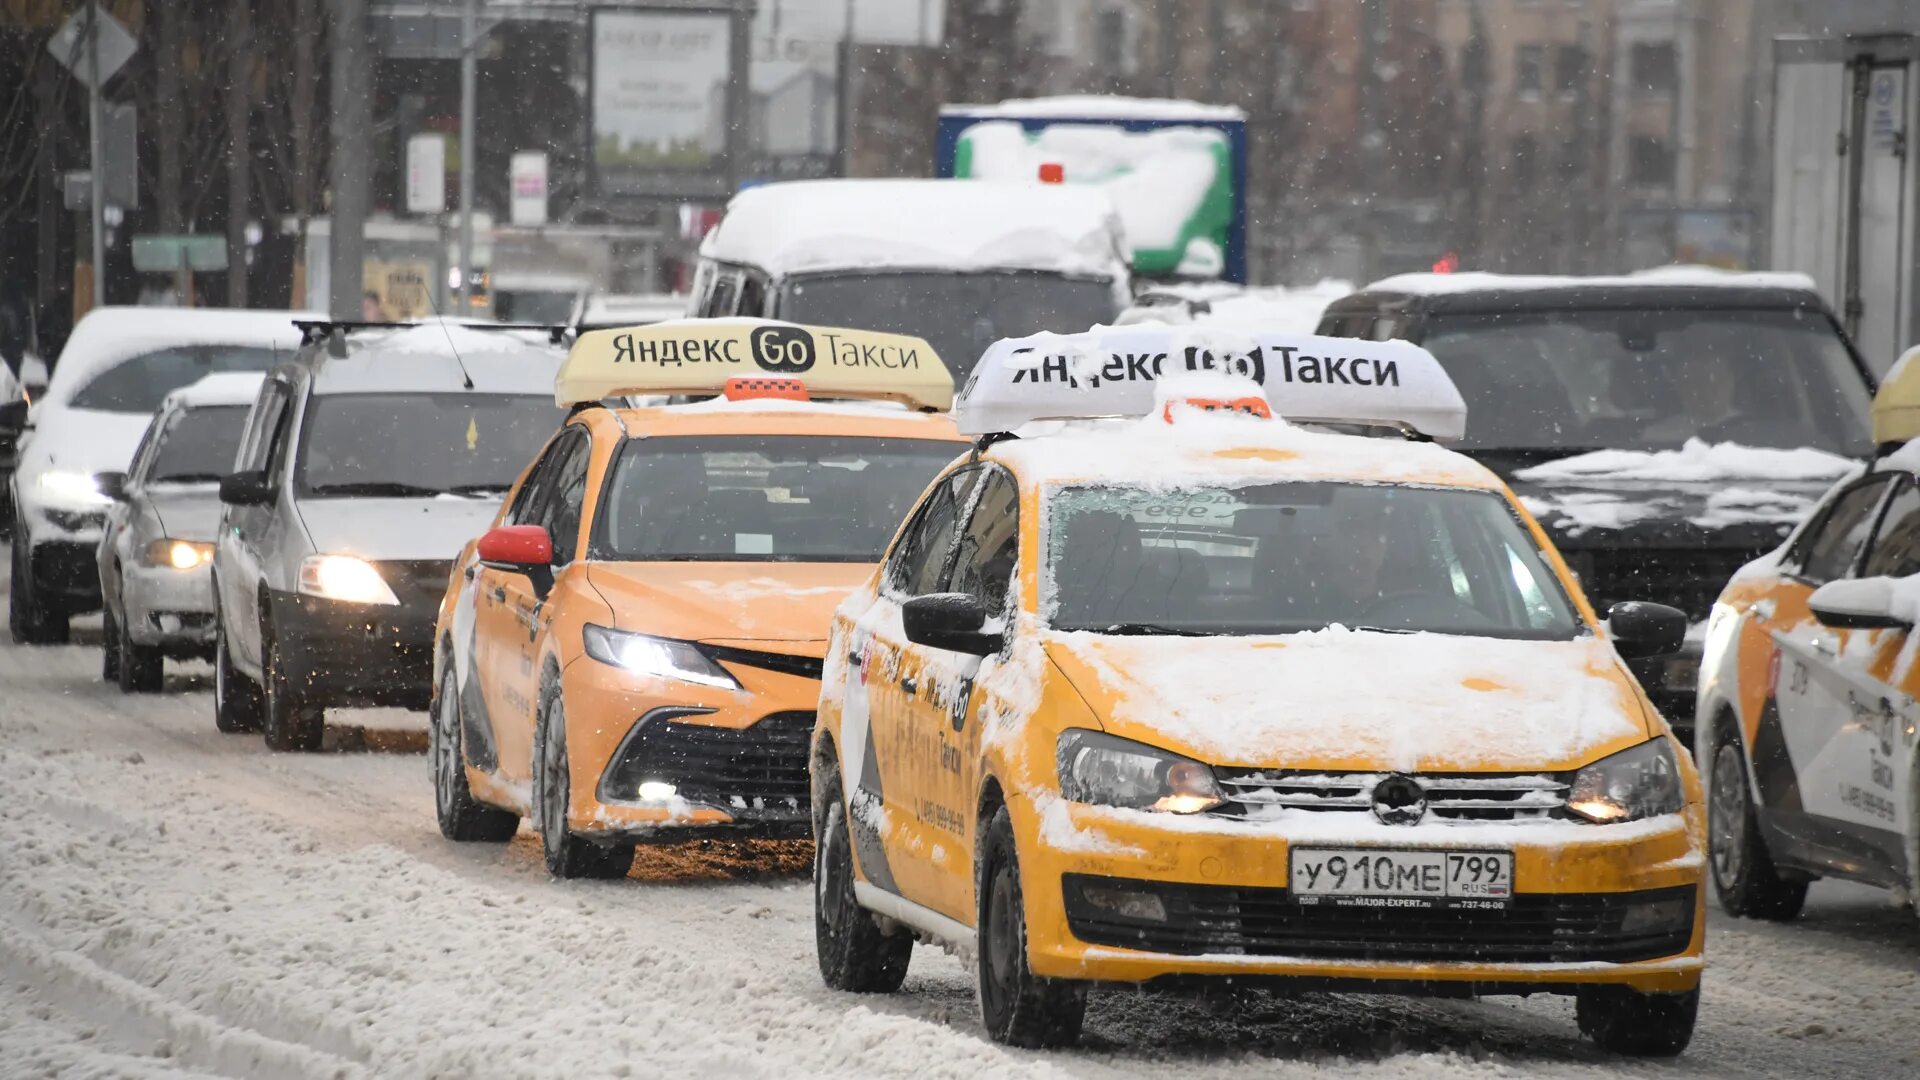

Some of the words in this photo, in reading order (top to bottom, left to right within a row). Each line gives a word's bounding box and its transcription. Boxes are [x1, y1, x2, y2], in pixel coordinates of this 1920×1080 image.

[613, 333, 741, 367] Яндекс
[757, 329, 809, 367] Go
[821, 334, 919, 369] Такси
[1271, 345, 1400, 387] Такси
[1449, 855, 1501, 883] 799
[1461, 883, 1488, 894] RUS
[1461, 900, 1505, 910] 737-46-00
